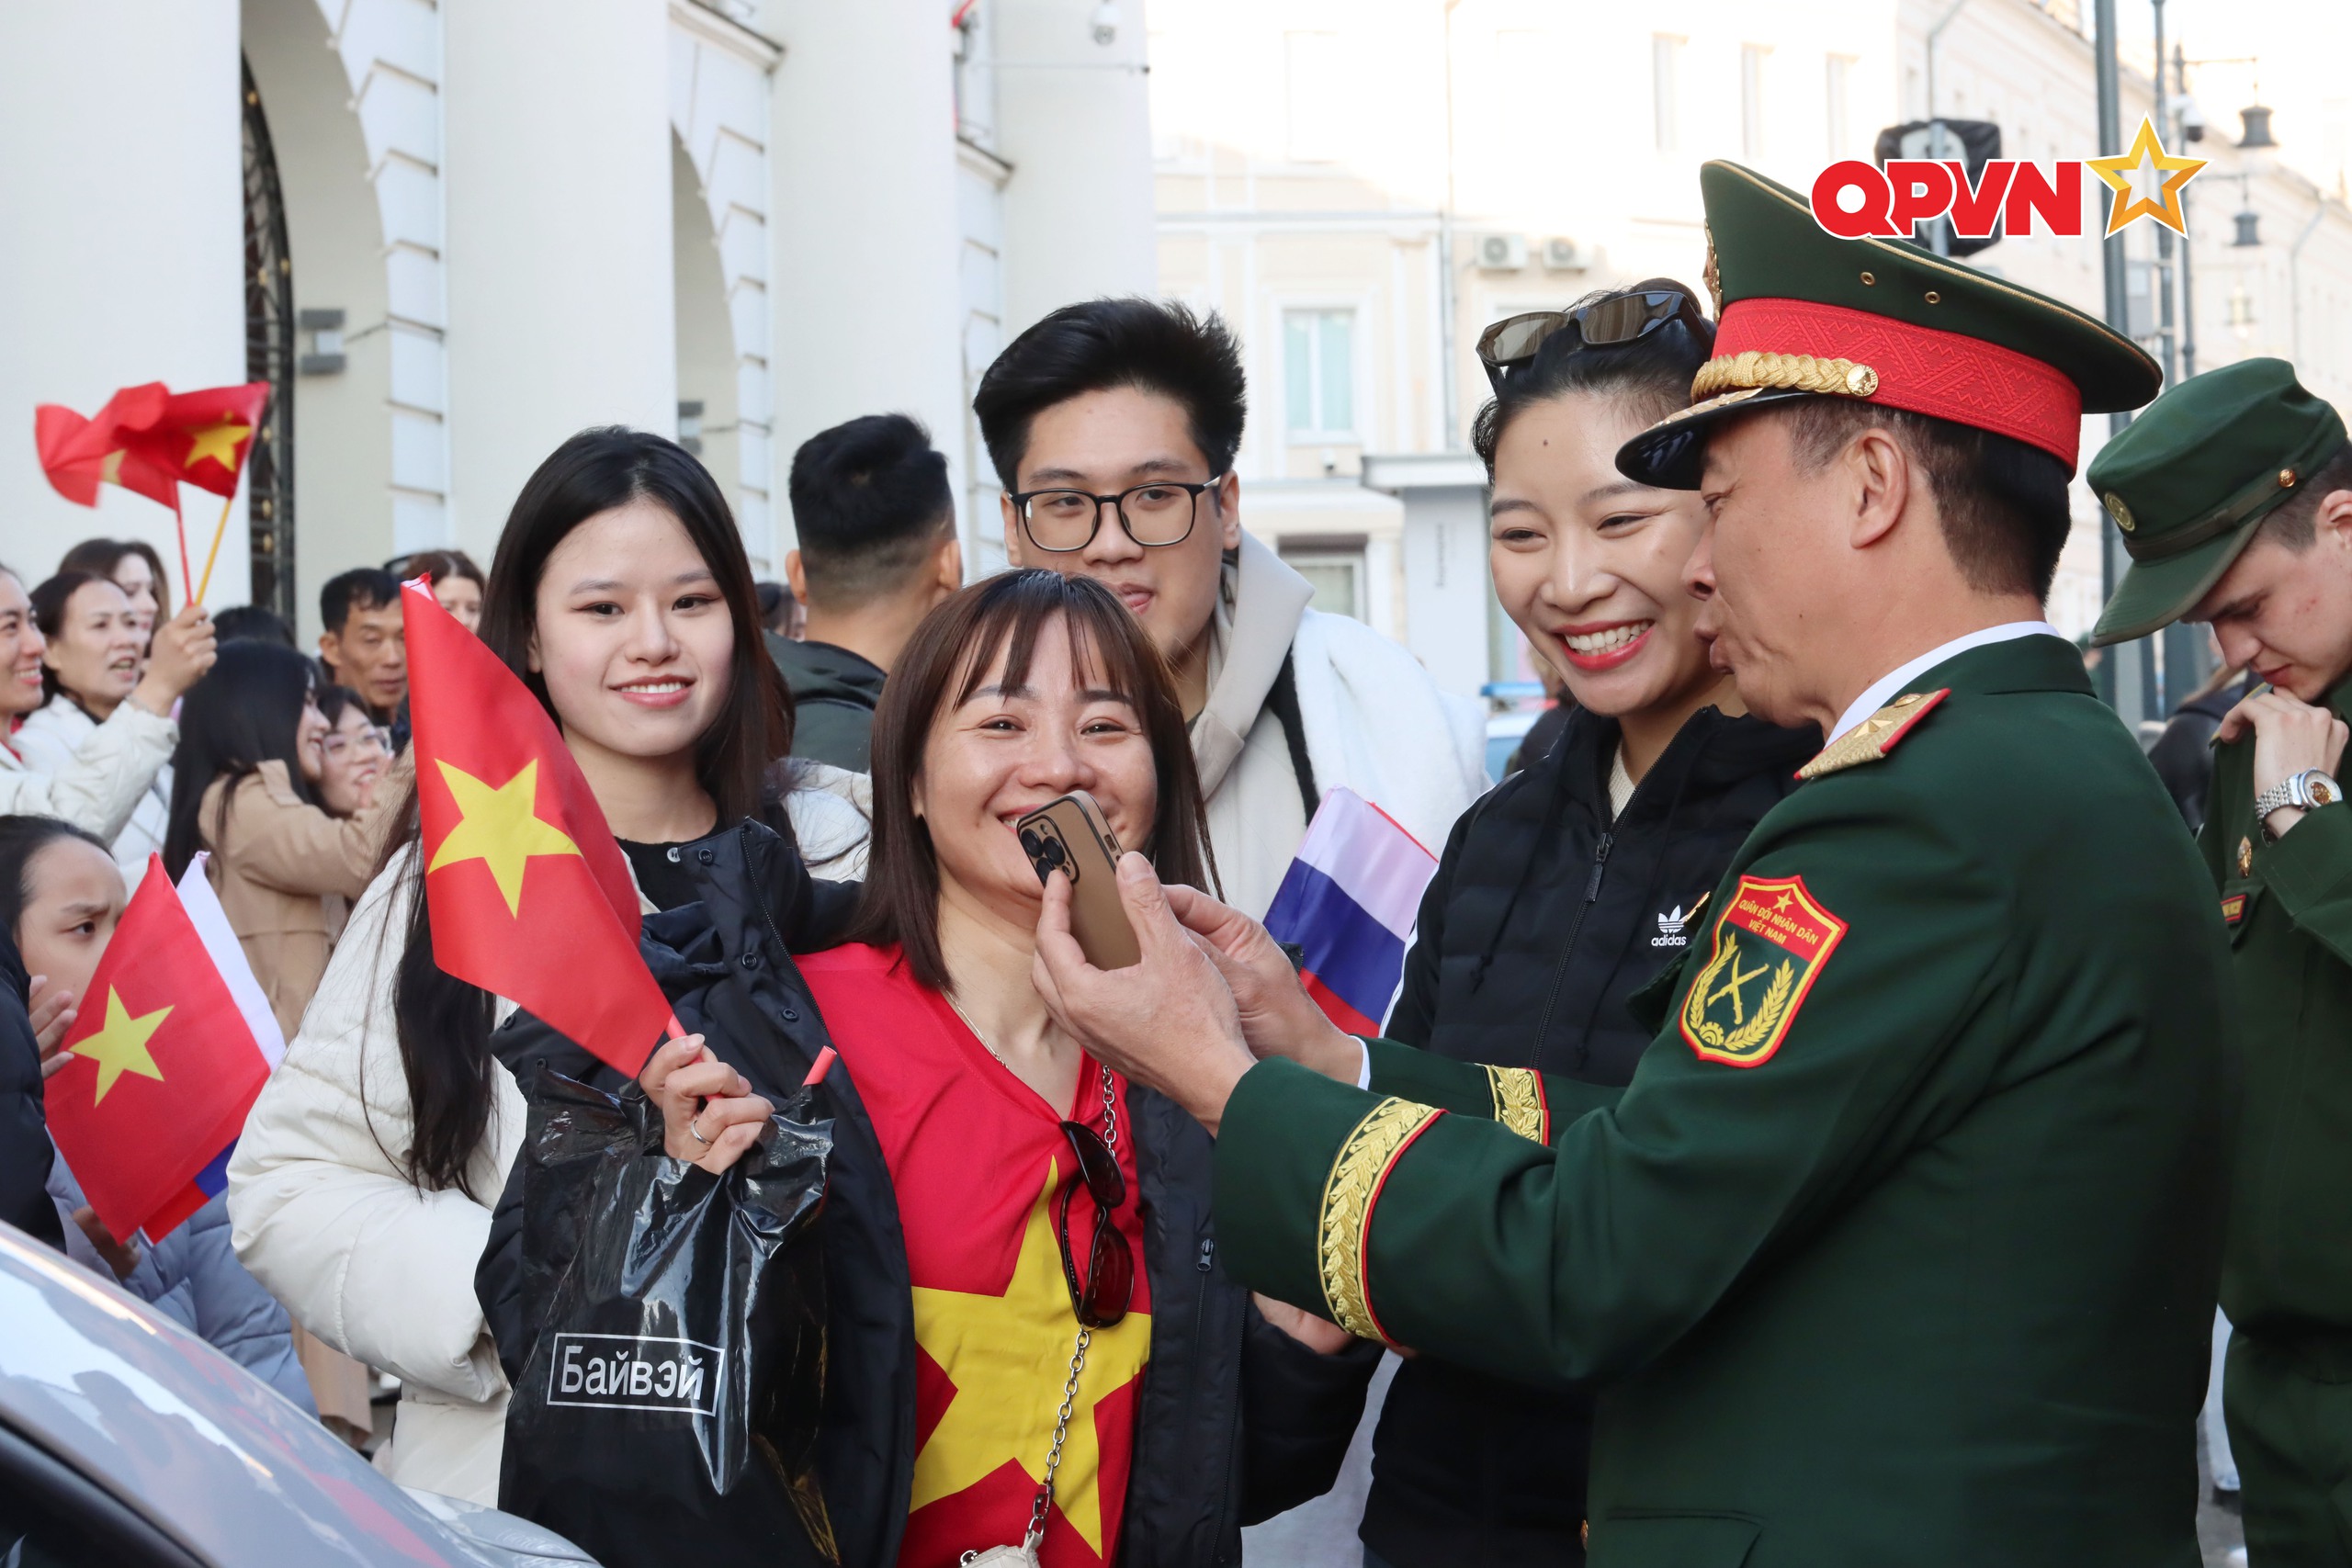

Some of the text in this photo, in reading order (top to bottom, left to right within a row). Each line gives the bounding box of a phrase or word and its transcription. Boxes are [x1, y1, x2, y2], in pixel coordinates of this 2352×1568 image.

[1738, 899, 1819, 945] QUÂN ĐỘI NHÂN DÂN
[1748, 919, 1787, 944] VIỆT NAM
[1651, 934, 1687, 947] adidas
[560, 1345, 705, 1400] Байвэй
